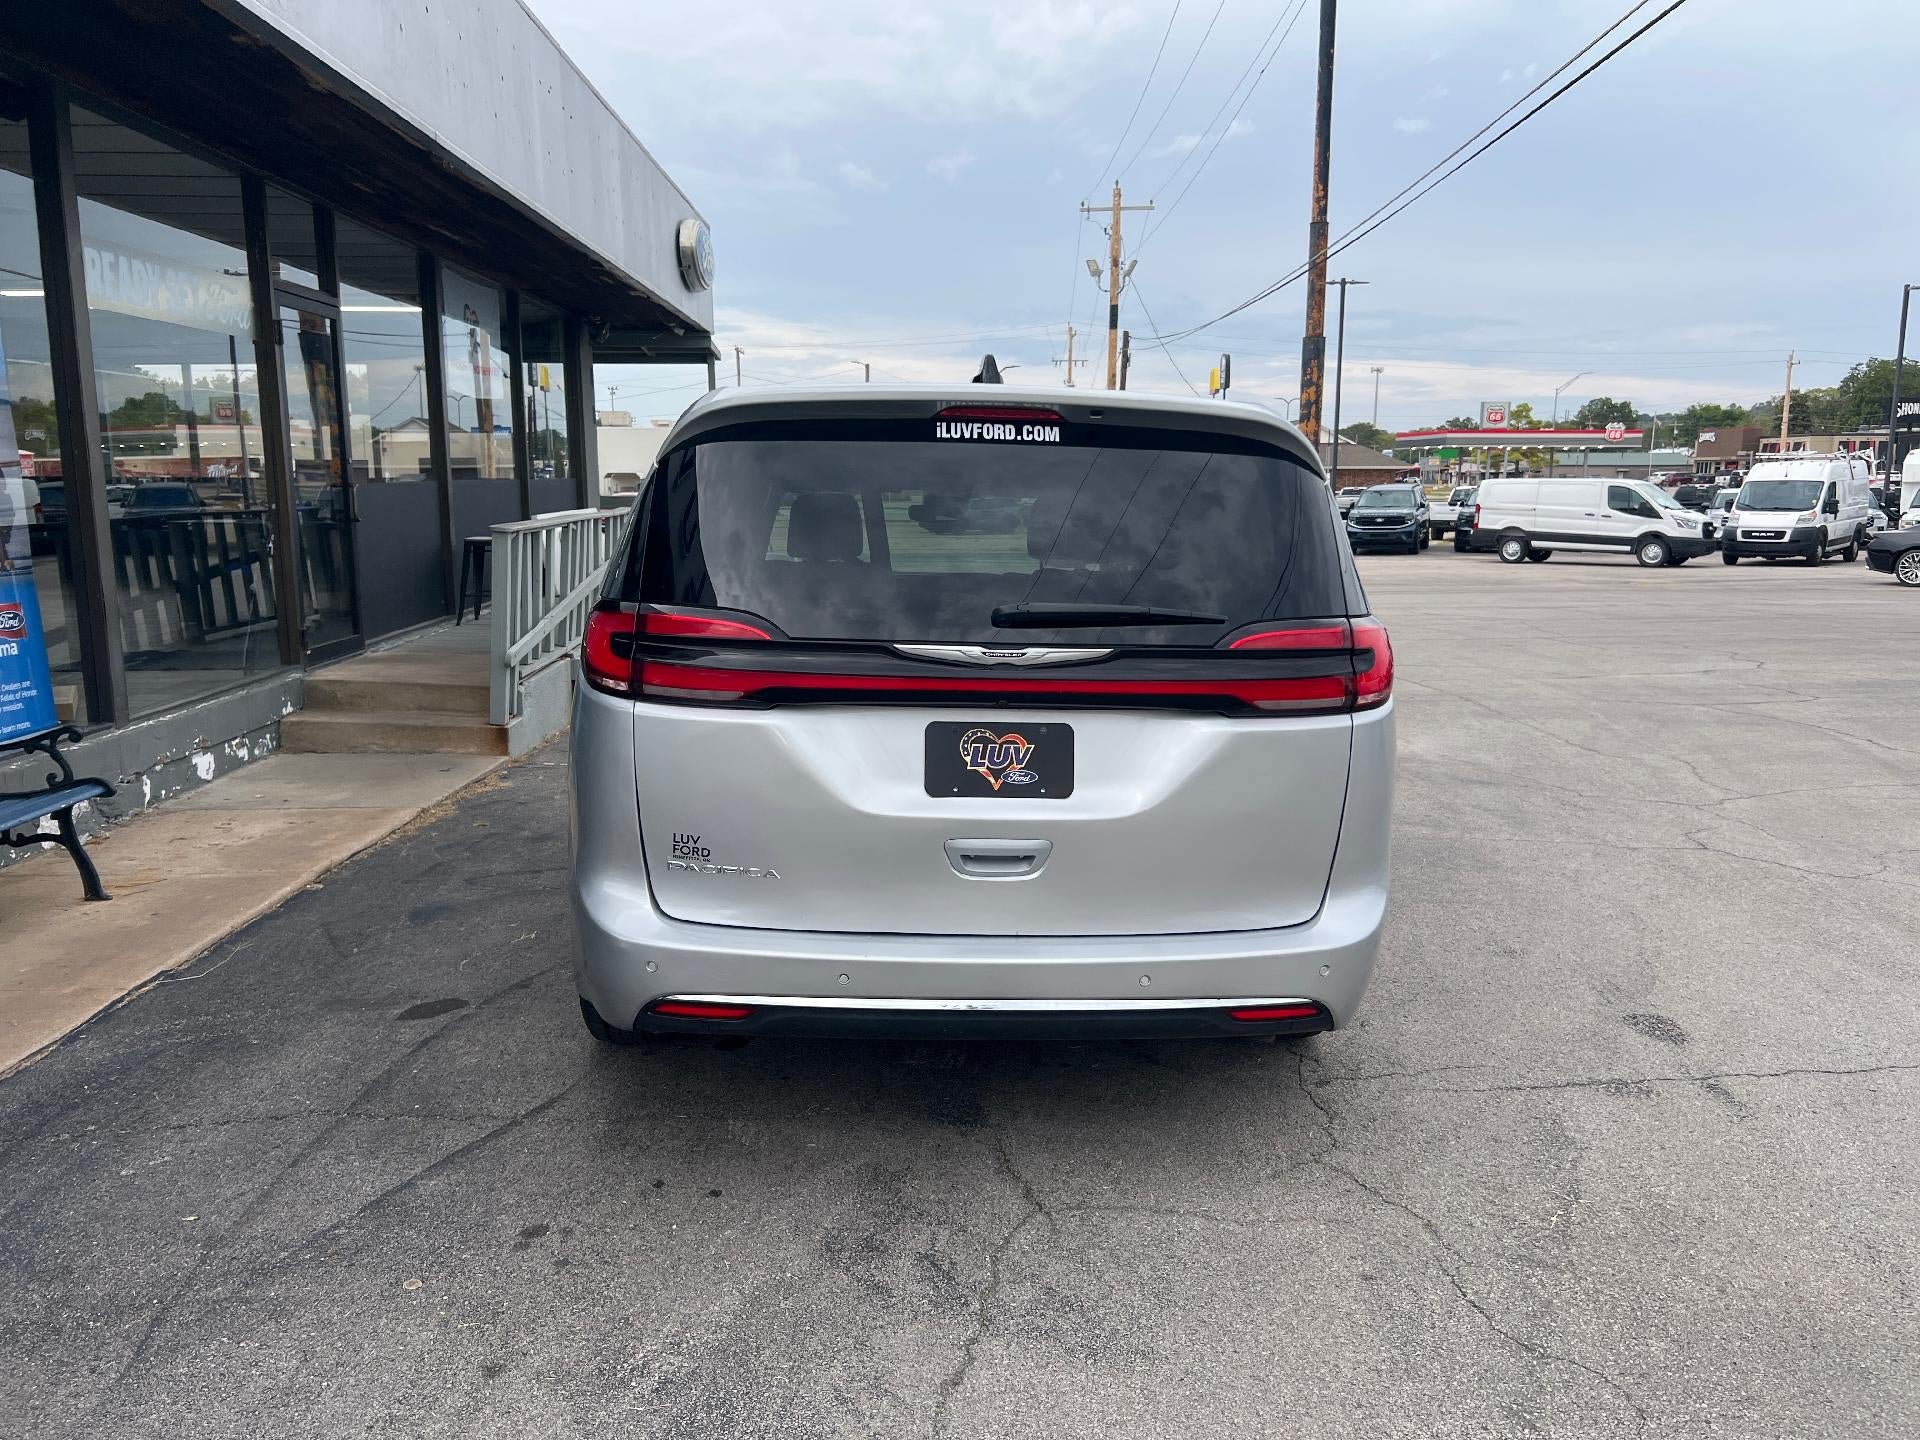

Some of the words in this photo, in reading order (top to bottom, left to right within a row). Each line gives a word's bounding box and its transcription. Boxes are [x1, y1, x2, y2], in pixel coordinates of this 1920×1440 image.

[1489, 412, 1502, 421] 66
[1896, 402, 1920, 418] SHON
[936, 421, 1060, 442] iLUVFORD.COM
[1609, 430, 1622, 439] 66
[967, 743, 1035, 770] LUV
[1007, 771, 1031, 782] Ford
[672, 832, 701, 845] LUV
[672, 843, 711, 858] FORD
[667, 859, 782, 880] PACIFICA
